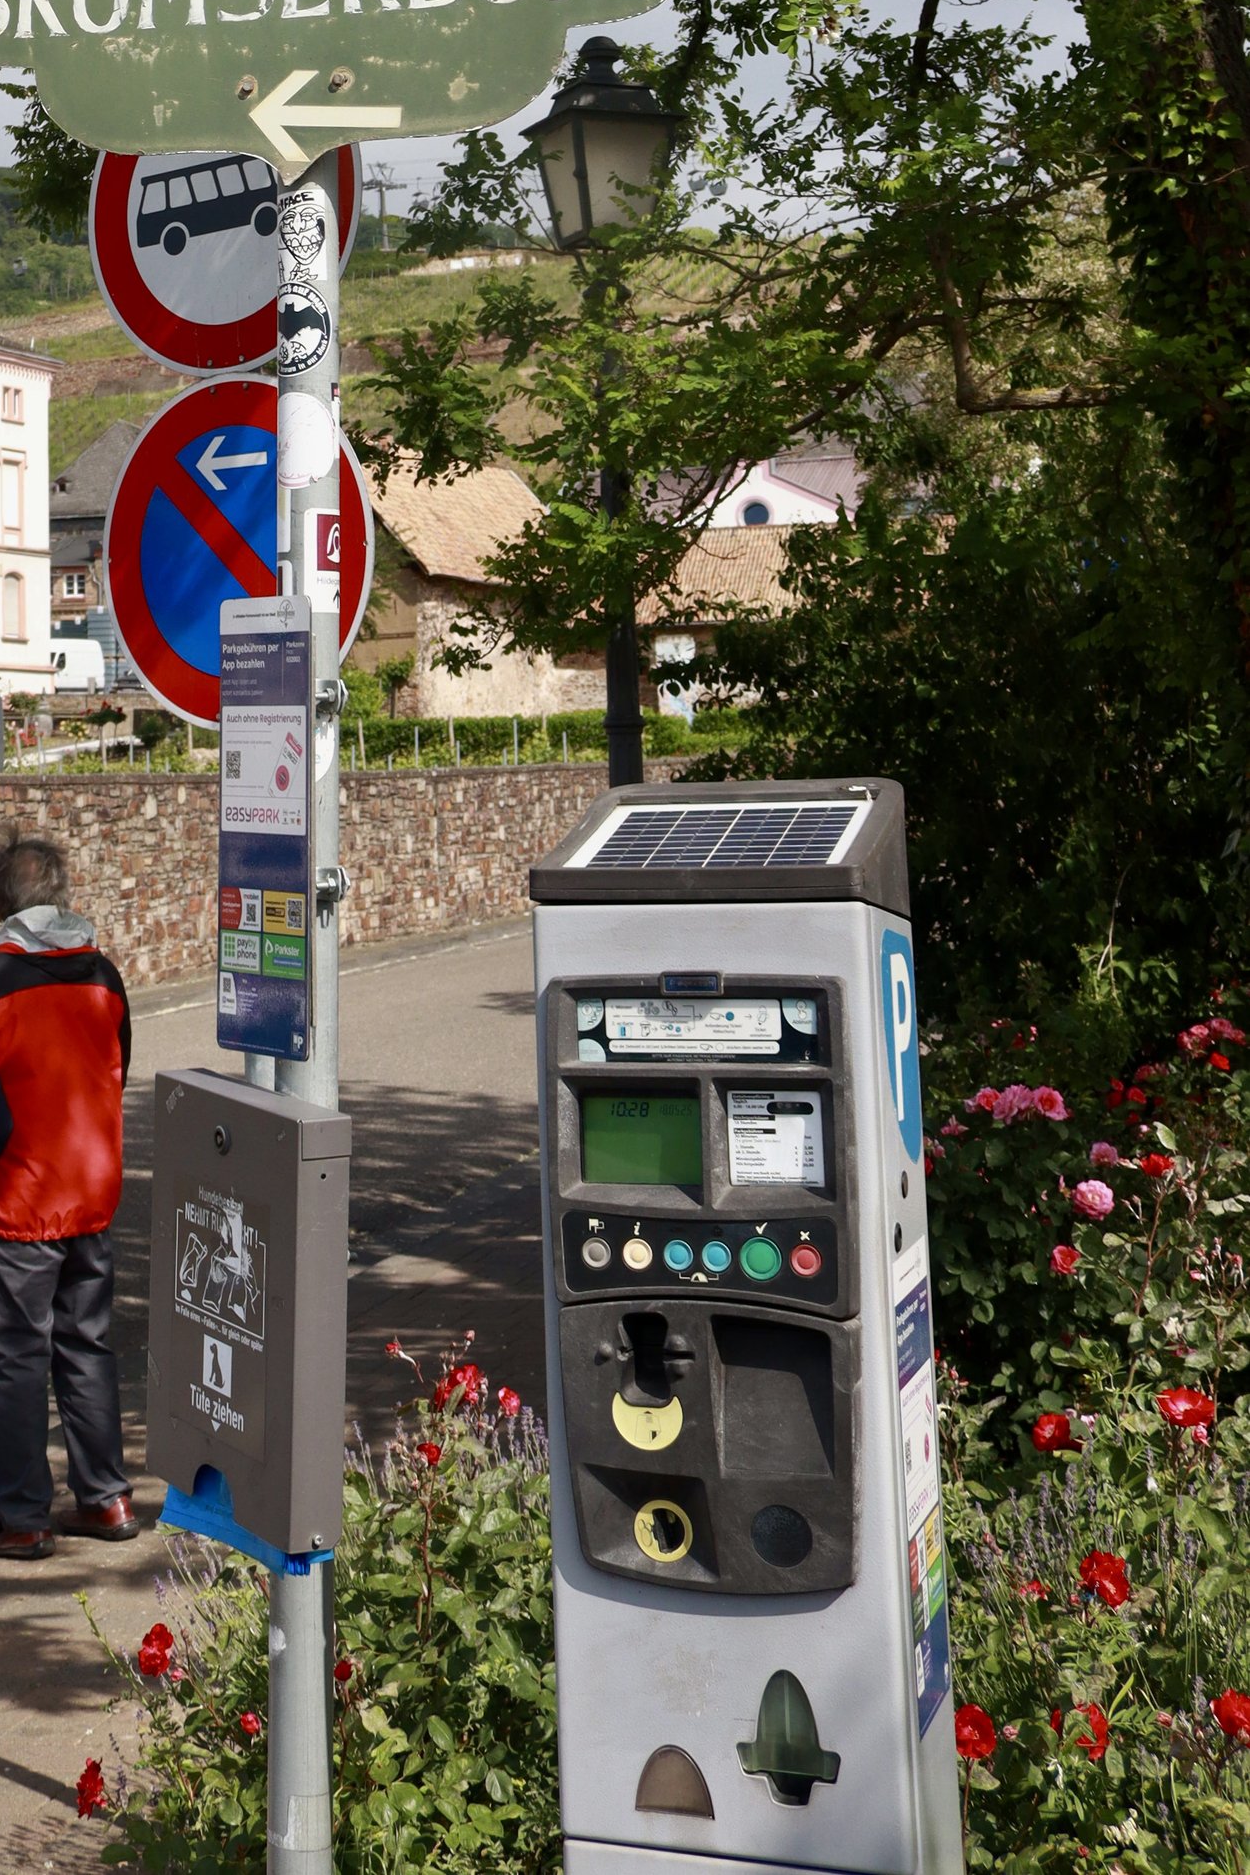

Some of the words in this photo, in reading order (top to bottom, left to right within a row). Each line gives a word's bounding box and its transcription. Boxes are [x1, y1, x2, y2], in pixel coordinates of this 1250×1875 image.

[222, 642, 266, 656] Parkgebühren
[267, 643, 280, 655] per
[222, 659, 236, 672] App
[236, 658, 265, 669] bezahlen
[226, 713, 242, 723] Auch
[243, 713, 258, 723] ohne
[260, 712, 302, 726] Registrierung
[236, 948, 258, 961] phone
[274, 943, 300, 957] Parkster
[890, 952, 911, 1122] P
[184, 1201, 210, 1229] NEHMT
[190, 1382, 211, 1415] Tüte
[212, 1398, 244, 1432] ziehen
